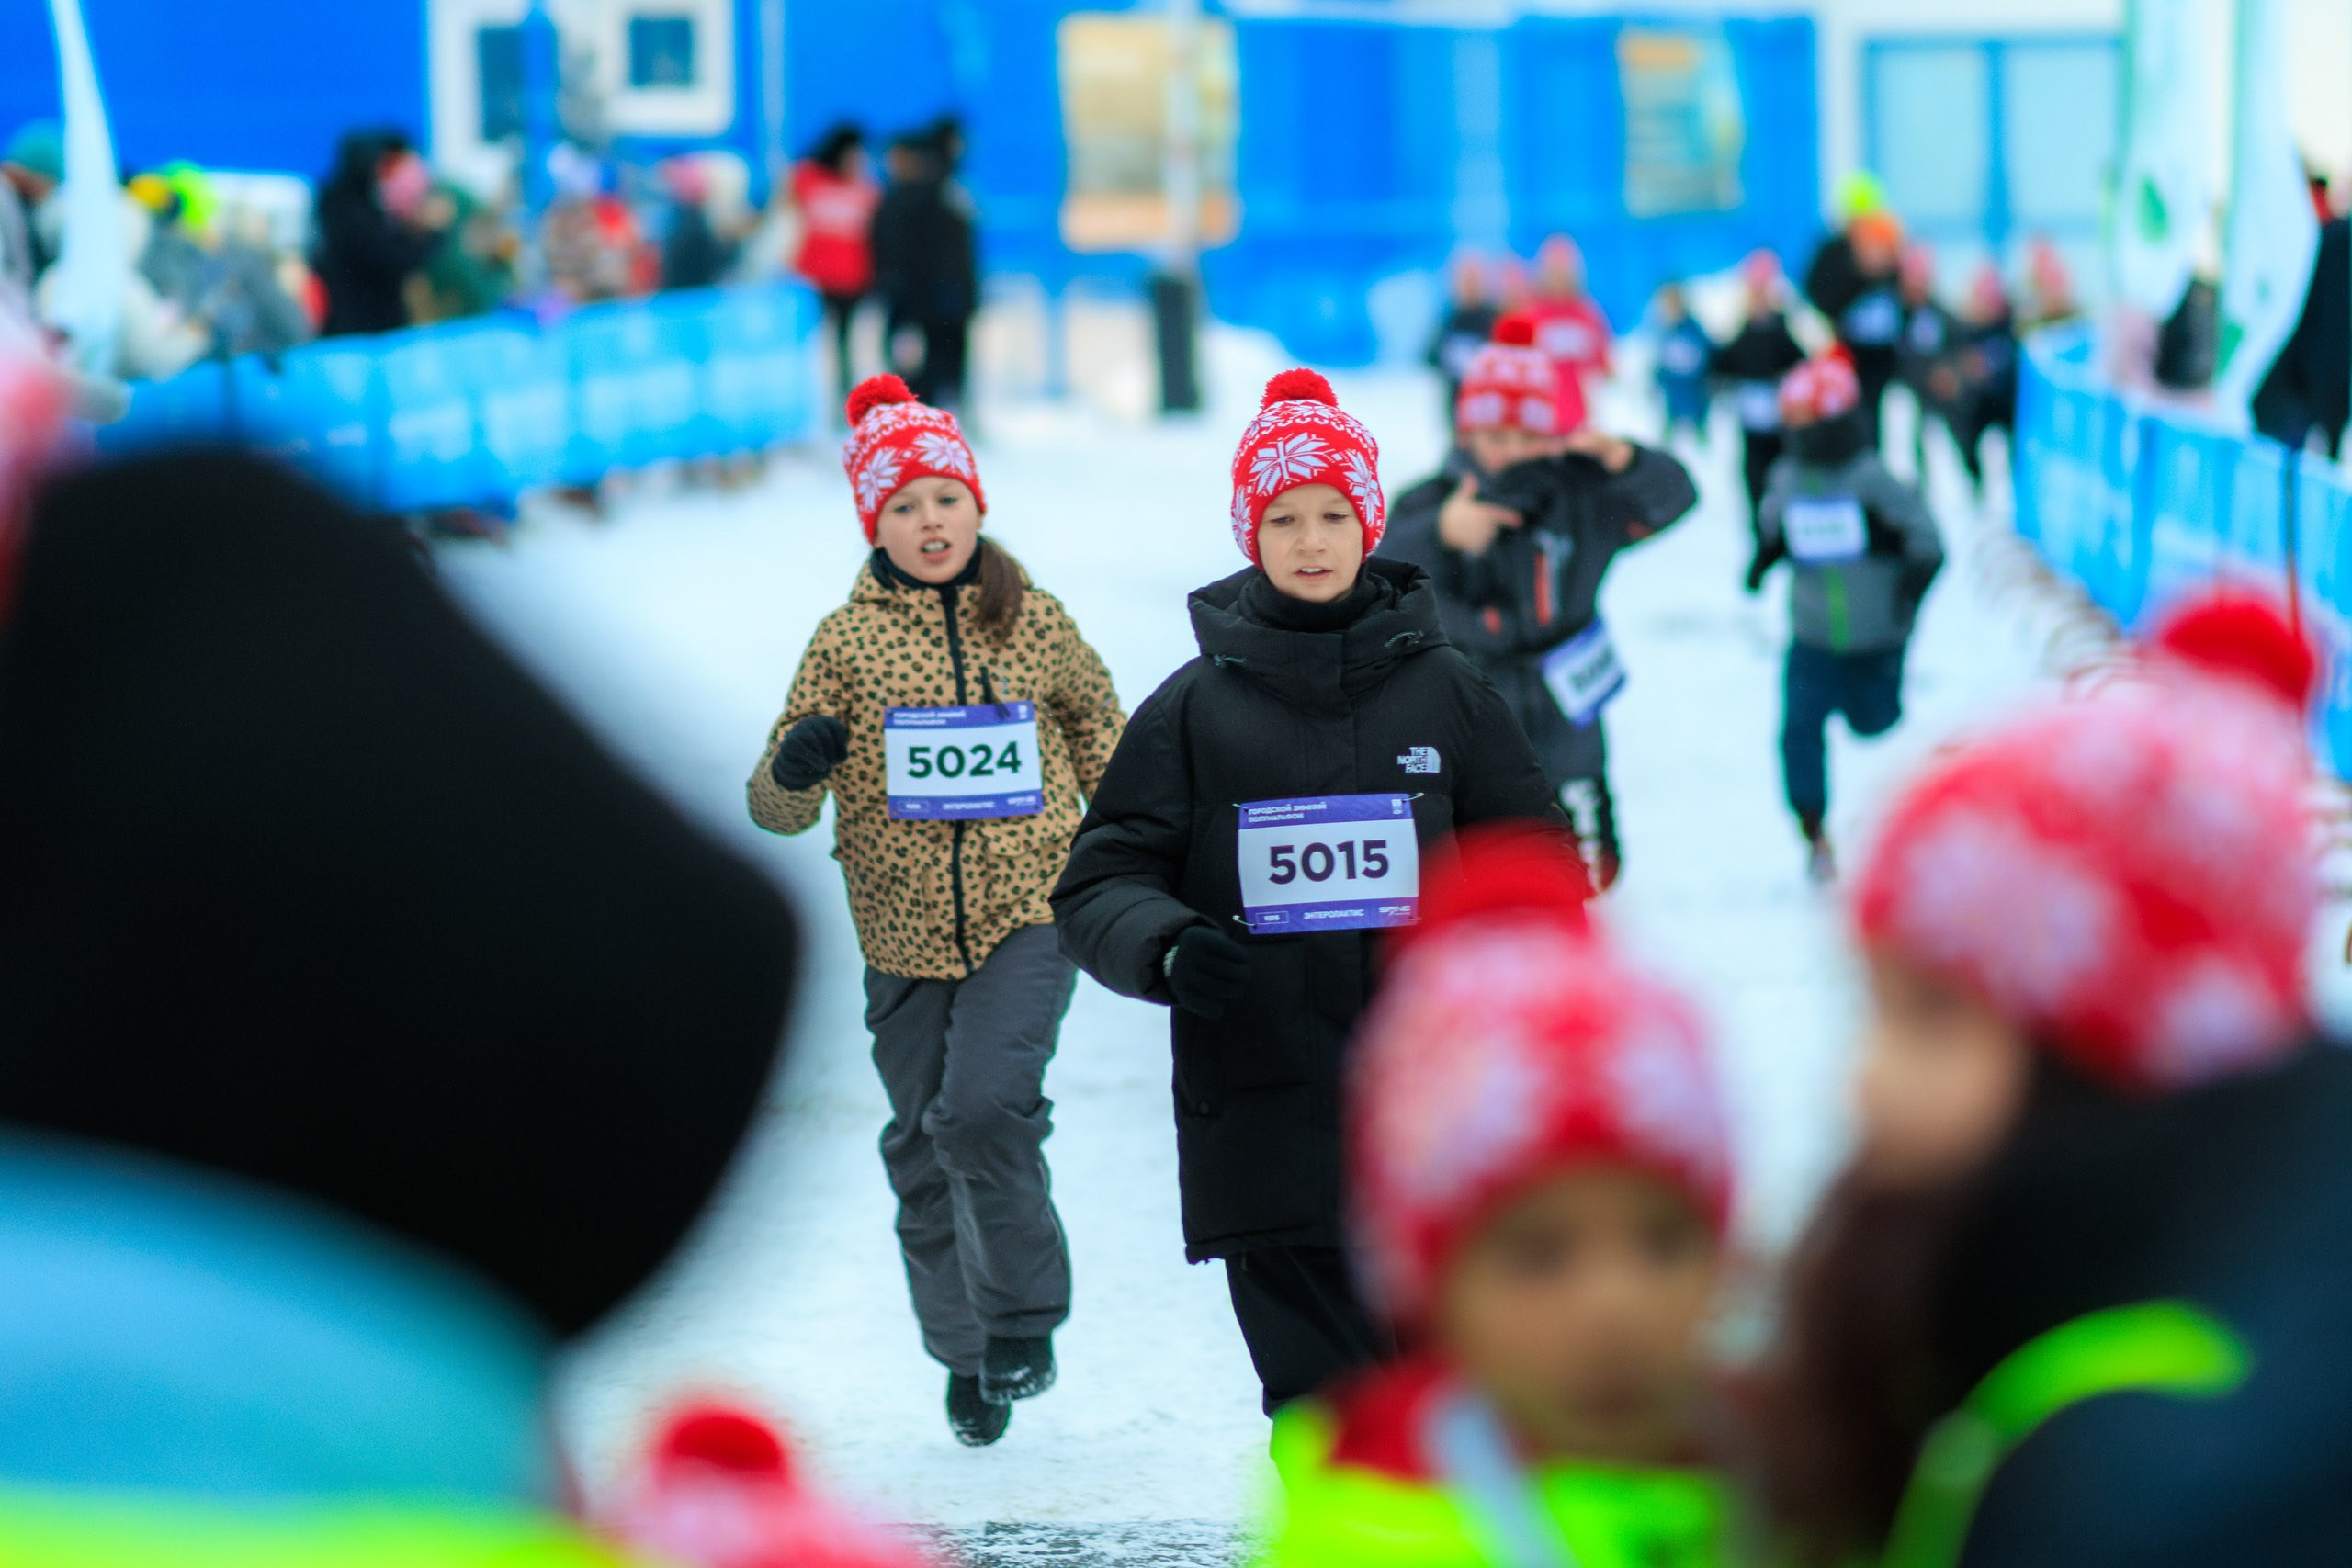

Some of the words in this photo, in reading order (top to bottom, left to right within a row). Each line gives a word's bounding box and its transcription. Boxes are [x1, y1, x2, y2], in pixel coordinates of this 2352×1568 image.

[1409, 746, 1427, 756] THE
[907, 740, 1022, 779] 5024
[1396, 755, 1427, 764] NORTH
[1405, 763, 1427, 773] FACE
[1268, 839, 1389, 885] 5015
